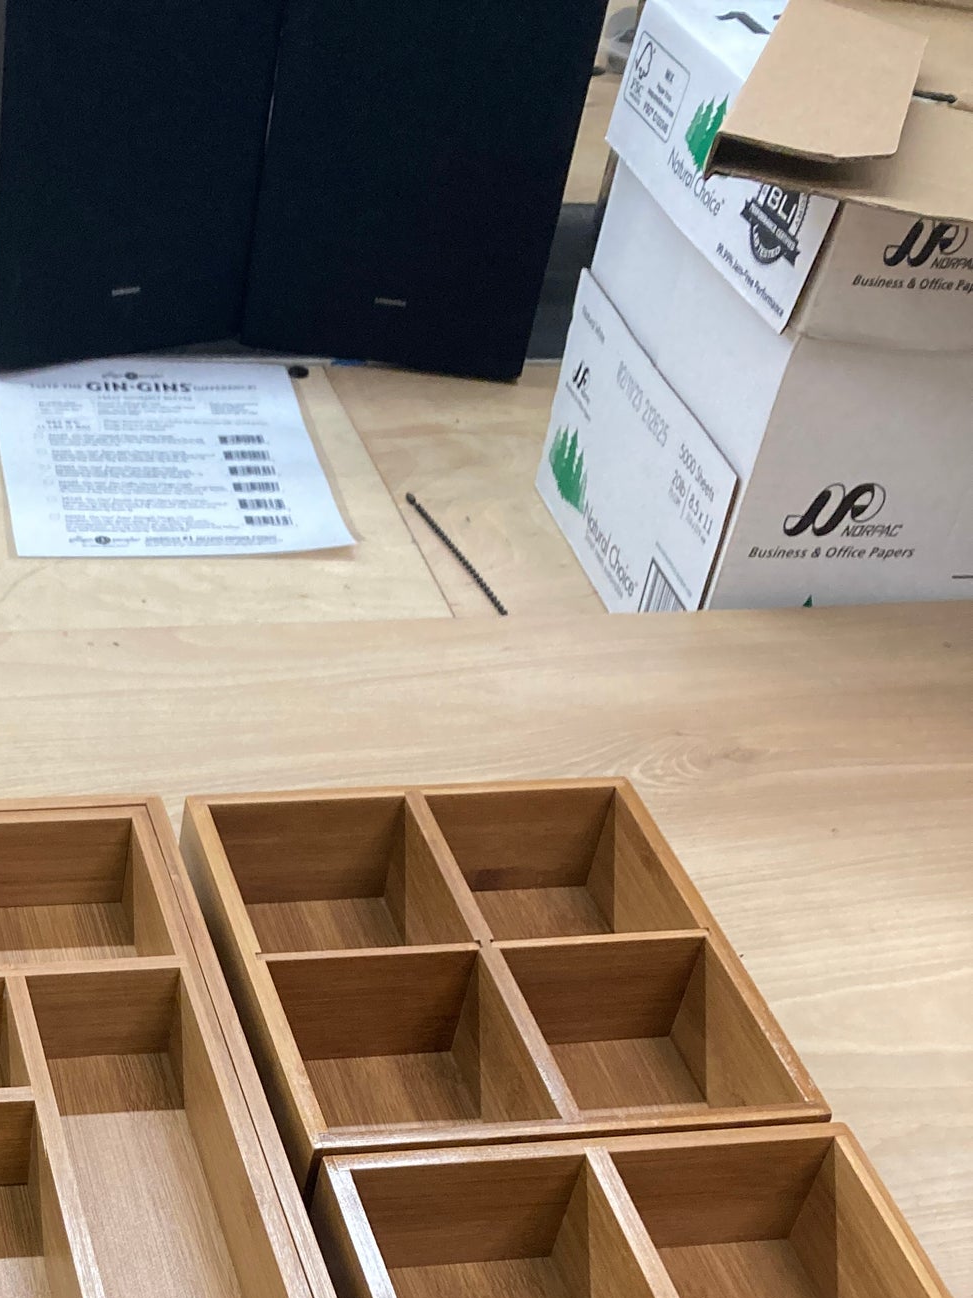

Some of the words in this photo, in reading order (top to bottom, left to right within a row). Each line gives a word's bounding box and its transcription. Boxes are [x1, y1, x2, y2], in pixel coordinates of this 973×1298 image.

[668, 149, 697, 189] Natural
[694, 170, 722, 216] Choice
[852, 274, 904, 289] Business
[907, 277, 916, 289] &
[919, 278, 954, 290] Office
[678, 443, 697, 475] 5000
[694, 464, 715, 503] Sheets
[583, 498, 613, 556] Natural
[608, 543, 636, 598] Choice
[840, 523, 904, 538] NORPAC
[747, 545, 807, 559] Business
[811, 546, 821, 559] &
[825, 546, 867, 559] Office
[867, 546, 916, 561] Papers
